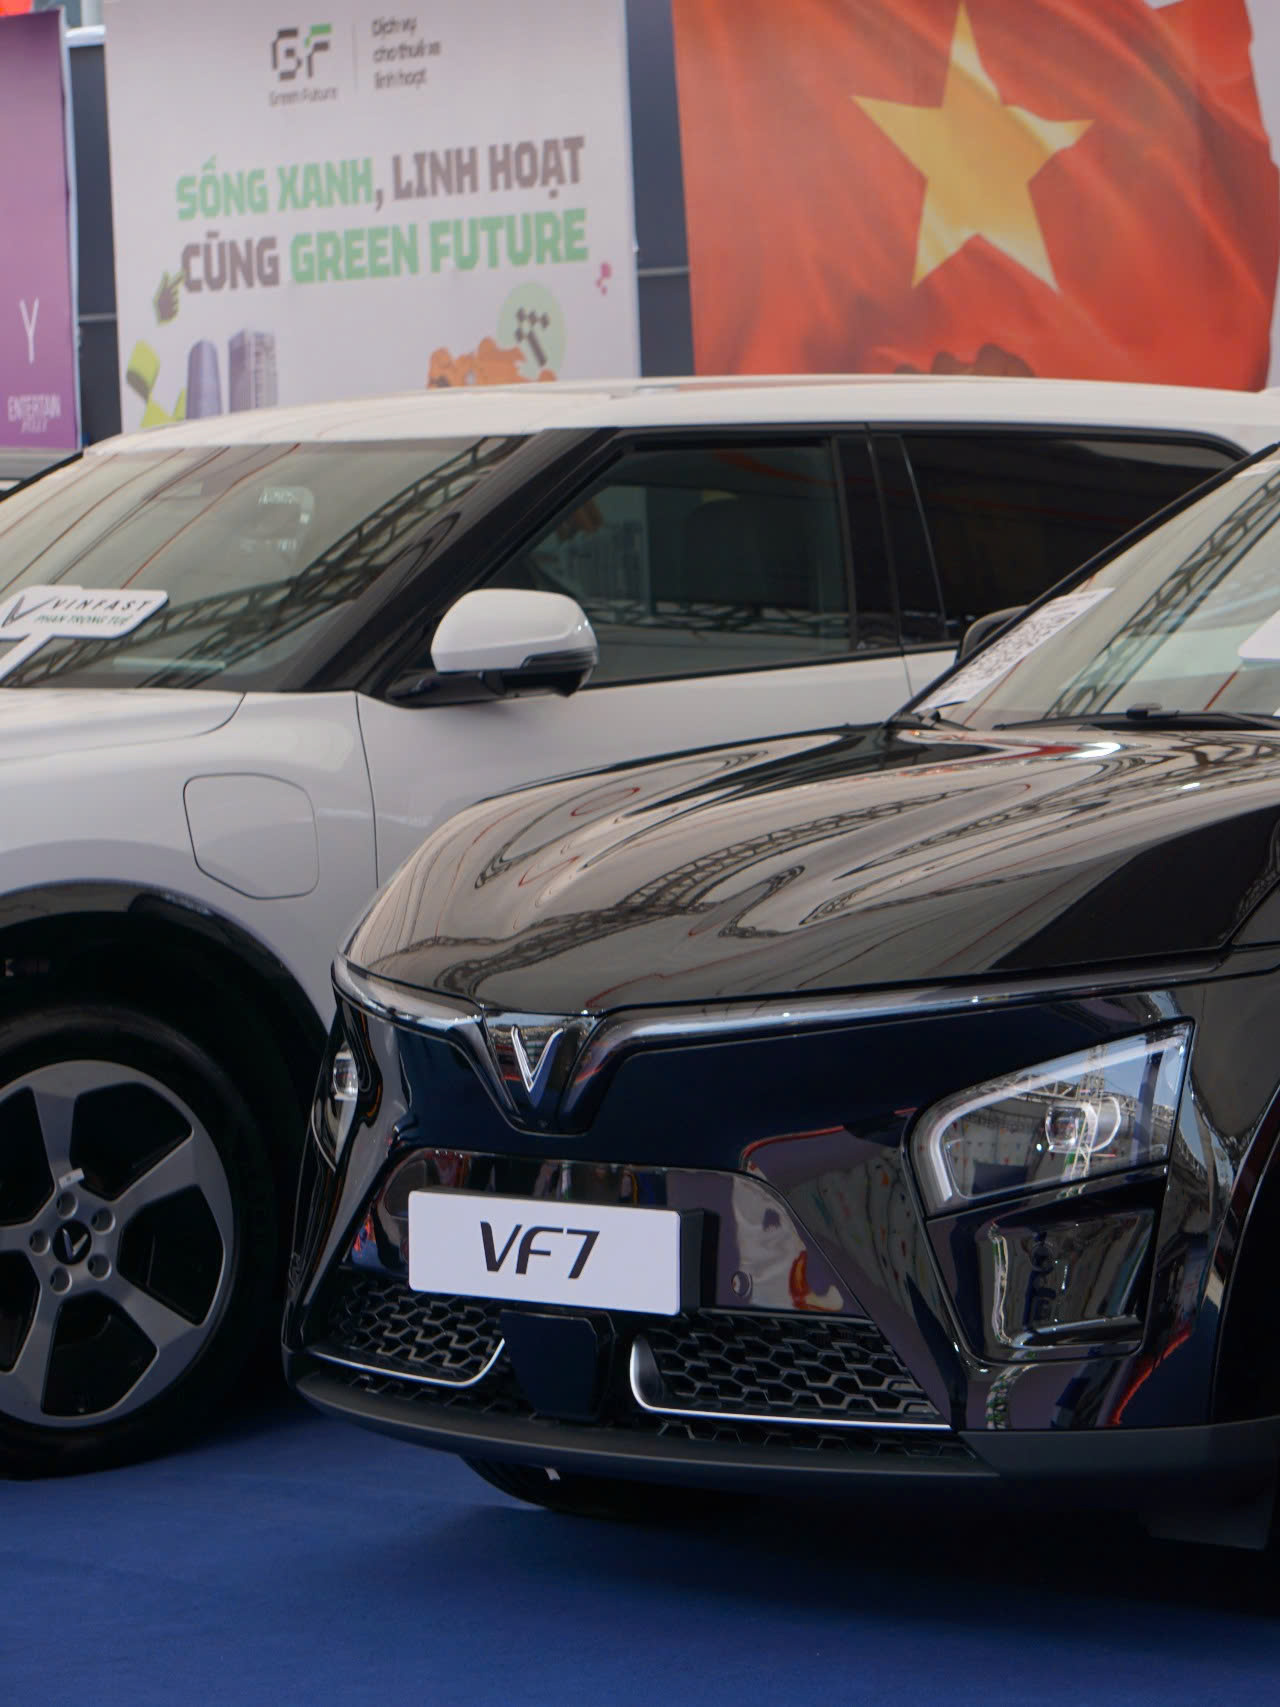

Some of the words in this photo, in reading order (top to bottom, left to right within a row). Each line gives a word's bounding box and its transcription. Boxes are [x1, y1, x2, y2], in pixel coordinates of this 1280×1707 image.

[176, 154, 269, 221] SỐNG
[276, 156, 383, 212] XANH,
[392, 145, 478, 200] LINH
[488, 136, 585, 198] HOẠT
[181, 230, 280, 293] CŨNG
[290, 223, 419, 284] GREEN
[429, 207, 589, 275] FUTURE
[53, 599, 151, 612] VINFAST
[480, 1221, 600, 1279] VF7
